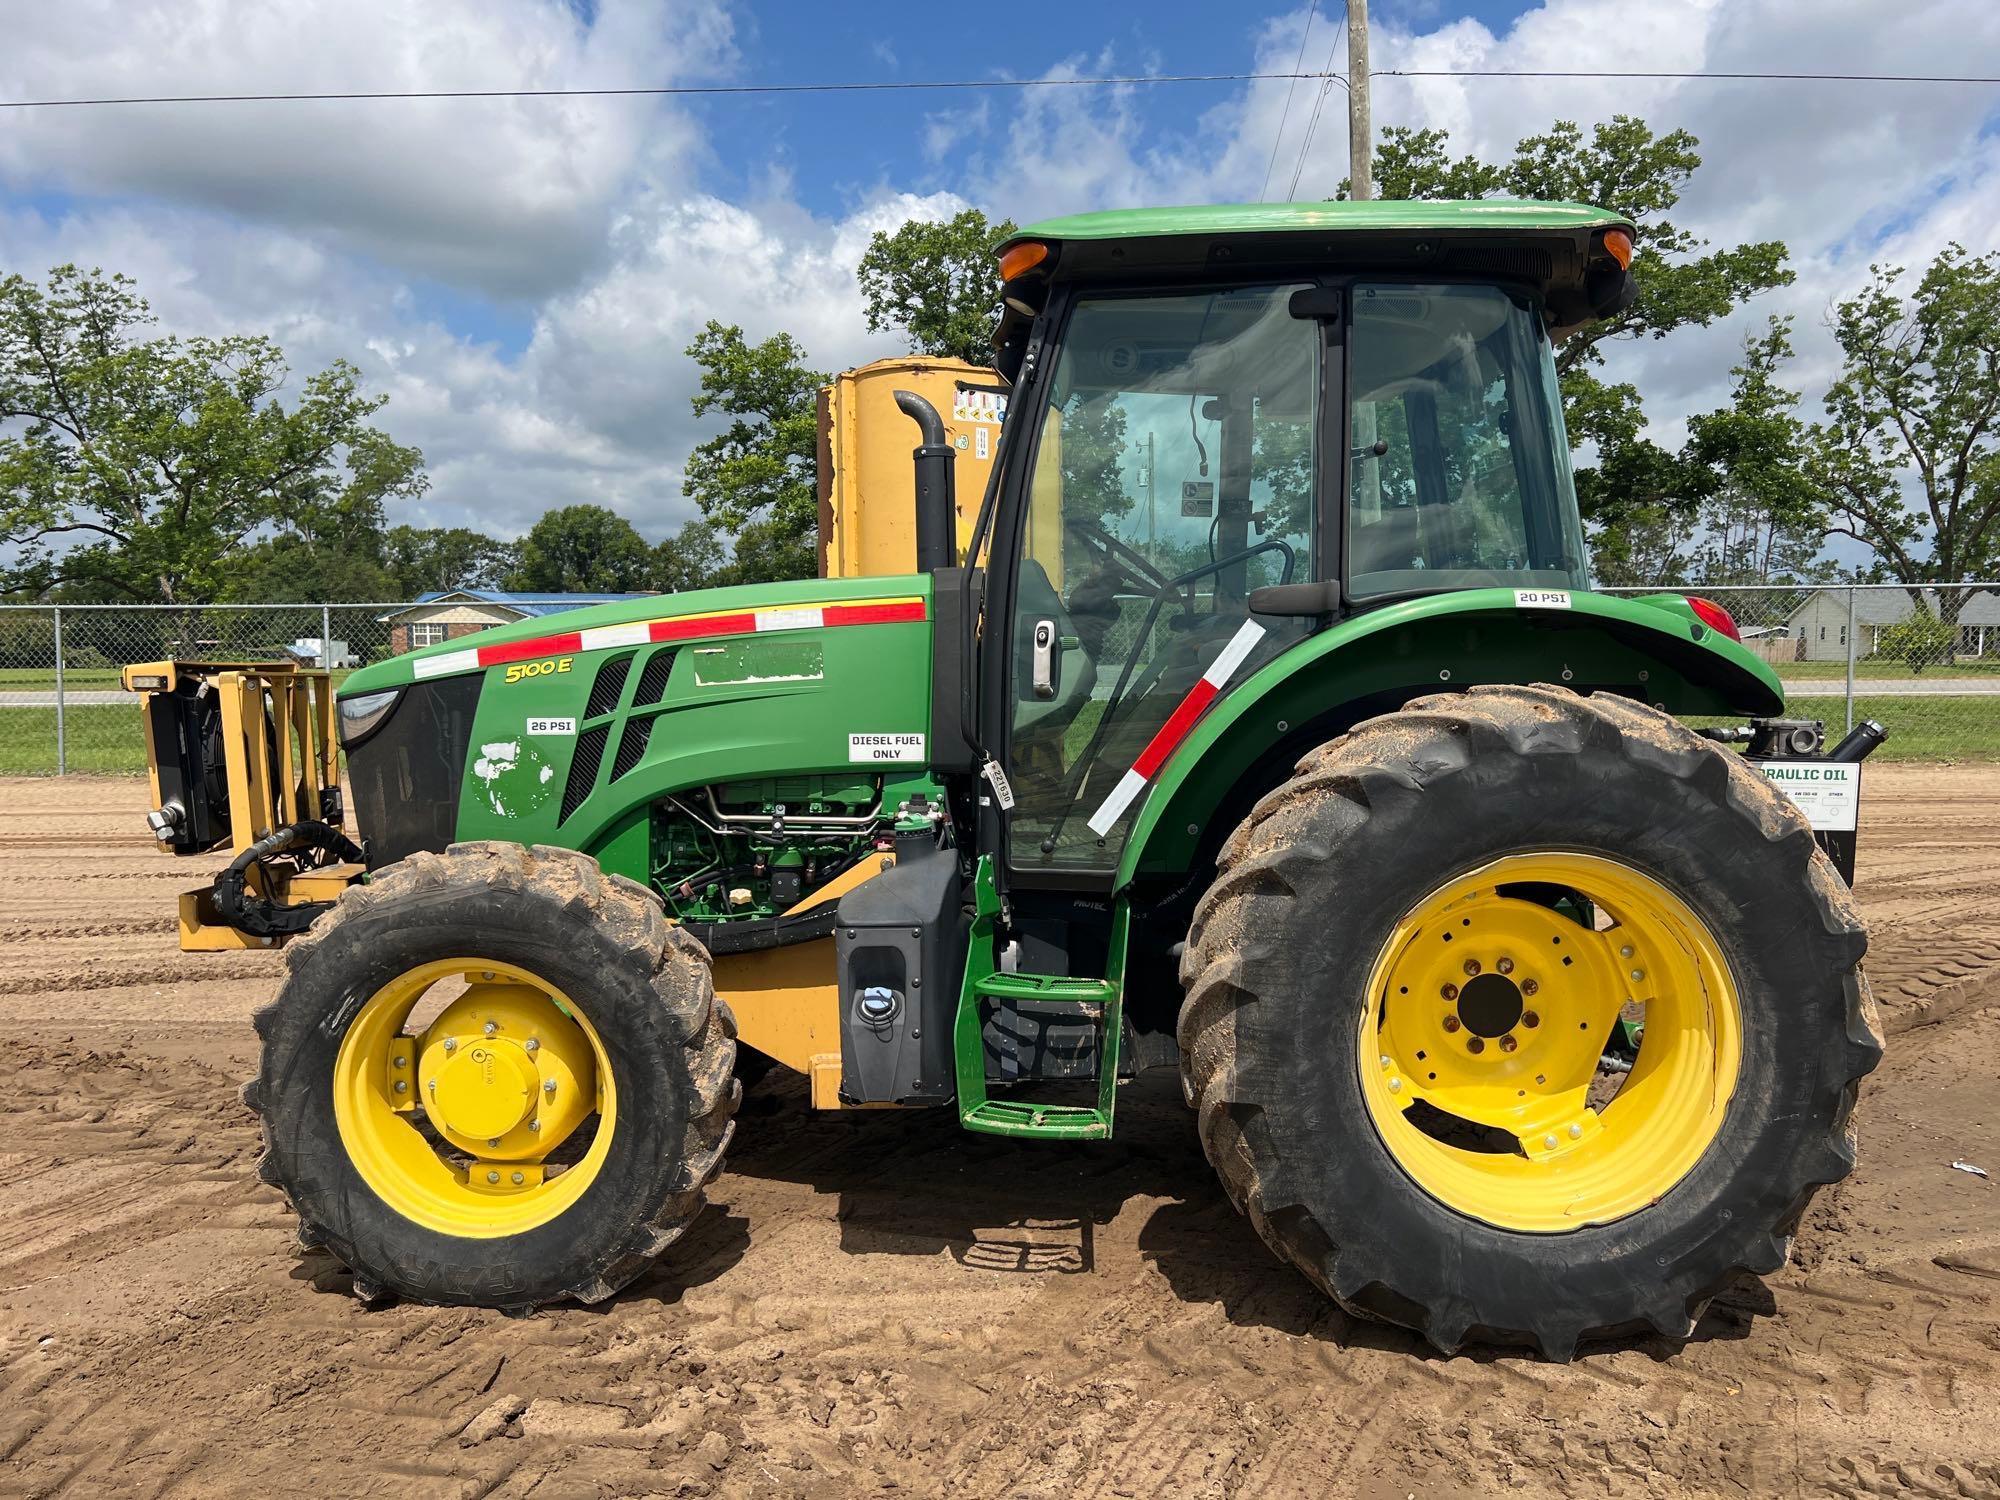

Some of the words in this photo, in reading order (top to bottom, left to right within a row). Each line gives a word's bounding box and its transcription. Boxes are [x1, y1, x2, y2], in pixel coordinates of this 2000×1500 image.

[1520, 593, 1538, 602] 20
[1542, 593, 1567, 603] PSI
[531, 722, 547, 731] 26
[550, 722, 571, 731] PSI
[852, 736, 892, 745] DIESEL
[895, 736, 922, 745] FUEL
[873, 750, 901, 759] ONLY
[1759, 768, 1820, 780] RAULIC
[1823, 769, 1848, 781] OIL
